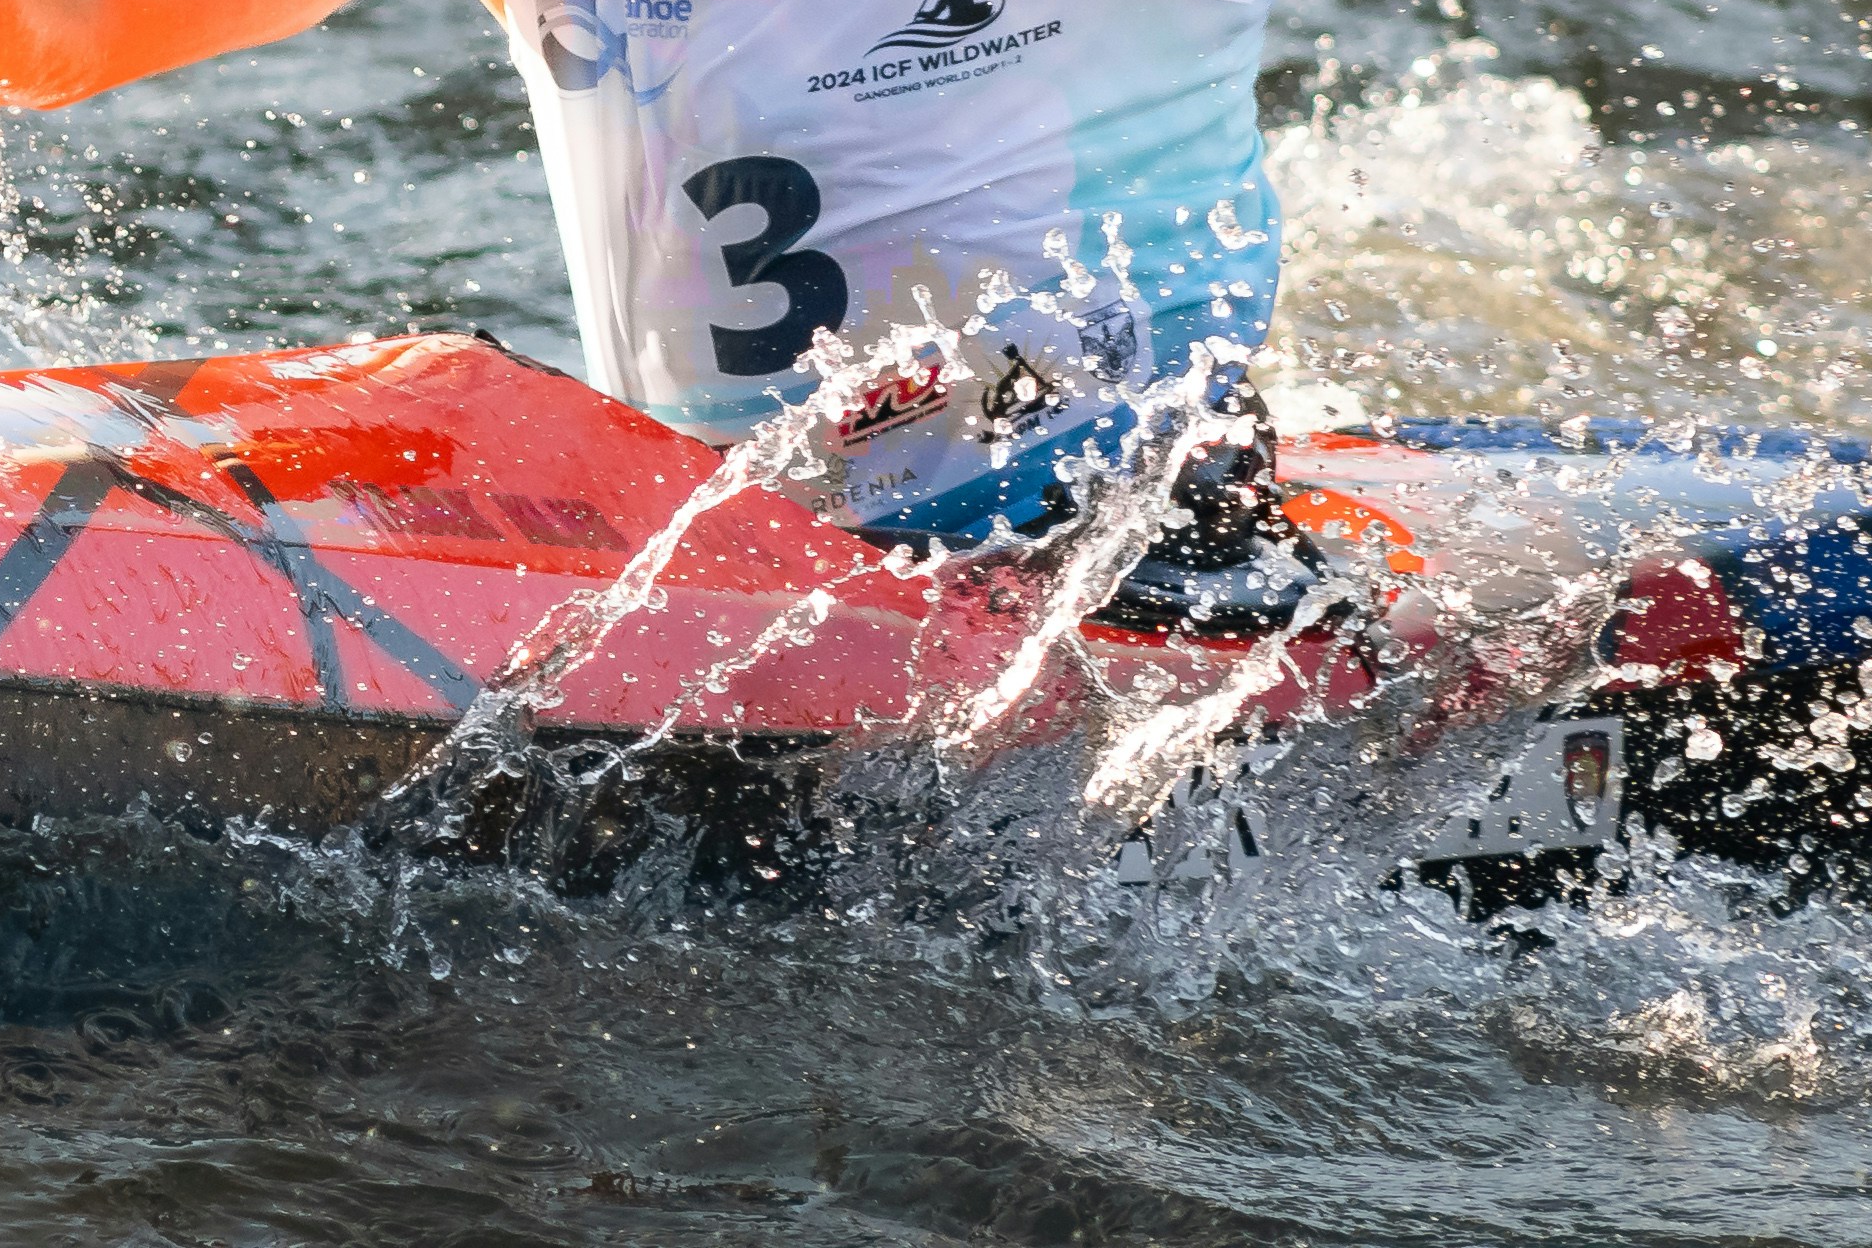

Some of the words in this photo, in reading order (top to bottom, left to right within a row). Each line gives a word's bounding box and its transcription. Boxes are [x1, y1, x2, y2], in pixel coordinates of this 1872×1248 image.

[807, 67, 867, 93] 2024
[872, 59, 913, 82] ICF
[918, 20, 1062, 73] WILDWATER
[853, 82, 922, 103] CANOEING
[924, 69, 971, 89] WORLD
[973, 62, 998, 77] CUP
[681, 155, 849, 377] 3
